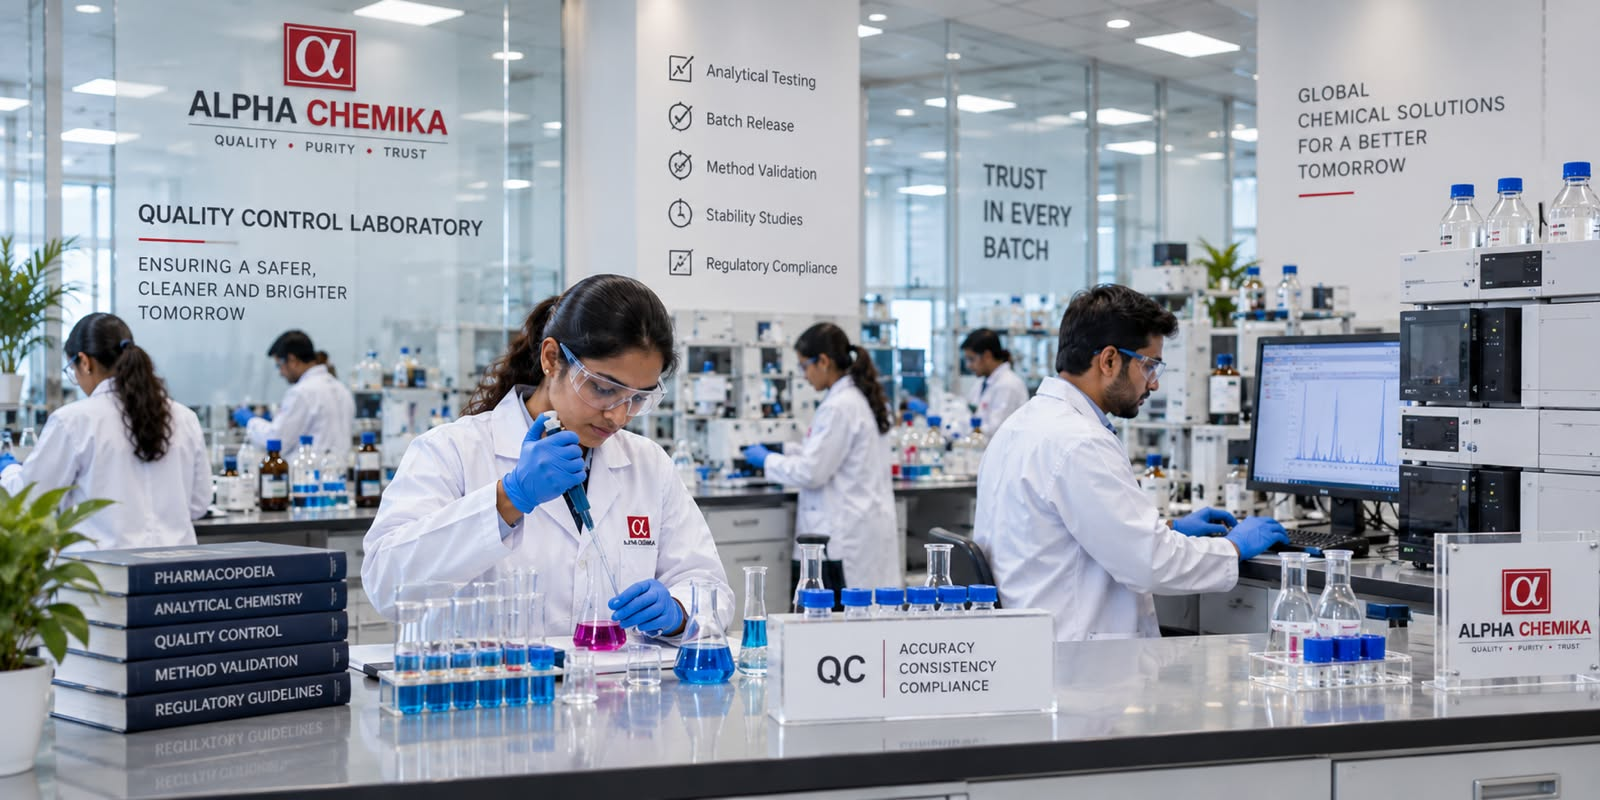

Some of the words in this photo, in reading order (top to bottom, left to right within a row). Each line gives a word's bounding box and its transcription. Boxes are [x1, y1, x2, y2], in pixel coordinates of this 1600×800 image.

[706, 63, 769, 84] Analytical
[771, 70, 816, 91] Testing
[1298, 82, 1370, 104] GLOBAL
[188, 89, 298, 124] ALPHA
[306, 99, 448, 136] CHEMIKA
[706, 111, 743, 128] Batch
[746, 115, 795, 133] Release
[1297, 106, 1391, 129] CHEMICAL
[1397, 95, 1505, 120] SOLUTIONS
[214, 134, 277, 150] QUALITY
[305, 141, 355, 155] PURITY
[383, 146, 427, 160] TRUST
[1298, 136, 1333, 154] FOR
[1339, 135, 1352, 152] A
[1358, 129, 1427, 150] BETTER
[706, 159, 755, 177] Method
[757, 163, 817, 181] Validation
[983, 163, 1048, 190] TRUST
[1297, 157, 1406, 180] TOMORROW
[138, 203, 235, 227] QUALITY
[241, 208, 344, 231] CONTROL
[350, 213, 484, 237] LABORATORY
[706, 207, 756, 227] Stability
[759, 210, 804, 226] Studies
[984, 199, 1004, 223] IN
[1011, 201, 1072, 227] EVERY
[983, 235, 1049, 261] BATCH
[138, 256, 232, 274] ENSURING
[238, 259, 251, 275] A
[257, 260, 316, 279] SAFER,
[706, 256, 770, 276] Regulatory
[772, 259, 838, 277] Compliance
[138, 280, 218, 297] CLEANER
[223, 282, 260, 298] AND
[266, 284, 347, 300] BRIGHTER
[137, 305, 246, 321] TOMORROW
[154, 565, 276, 585] PHARMACOPOEIA
[154, 597, 233, 616] ANALYTICAL
[234, 592, 303, 609] CHEMISTRY
[154, 630, 216, 650] QUALITY
[218, 624, 283, 642] CONTROL
[1458, 621, 1515, 639] ALPHA
[1518, 619, 1592, 637] CHEMIKA
[899, 641, 975, 655] ACCURACY
[1471, 645, 1503, 654] QUALITY
[1517, 644, 1544, 652] PURITY
[1557, 642, 1580, 650] TRUST
[155, 662, 217, 682] METHOD
[219, 654, 299, 674] VALIDATION
[816, 654, 866, 687] QC
[899, 660, 997, 675] CONSISTENCY
[899, 679, 989, 694] COMPLIANCE
[155, 693, 245, 717] REGULATORY
[247, 684, 323, 705] GUIDELINES
